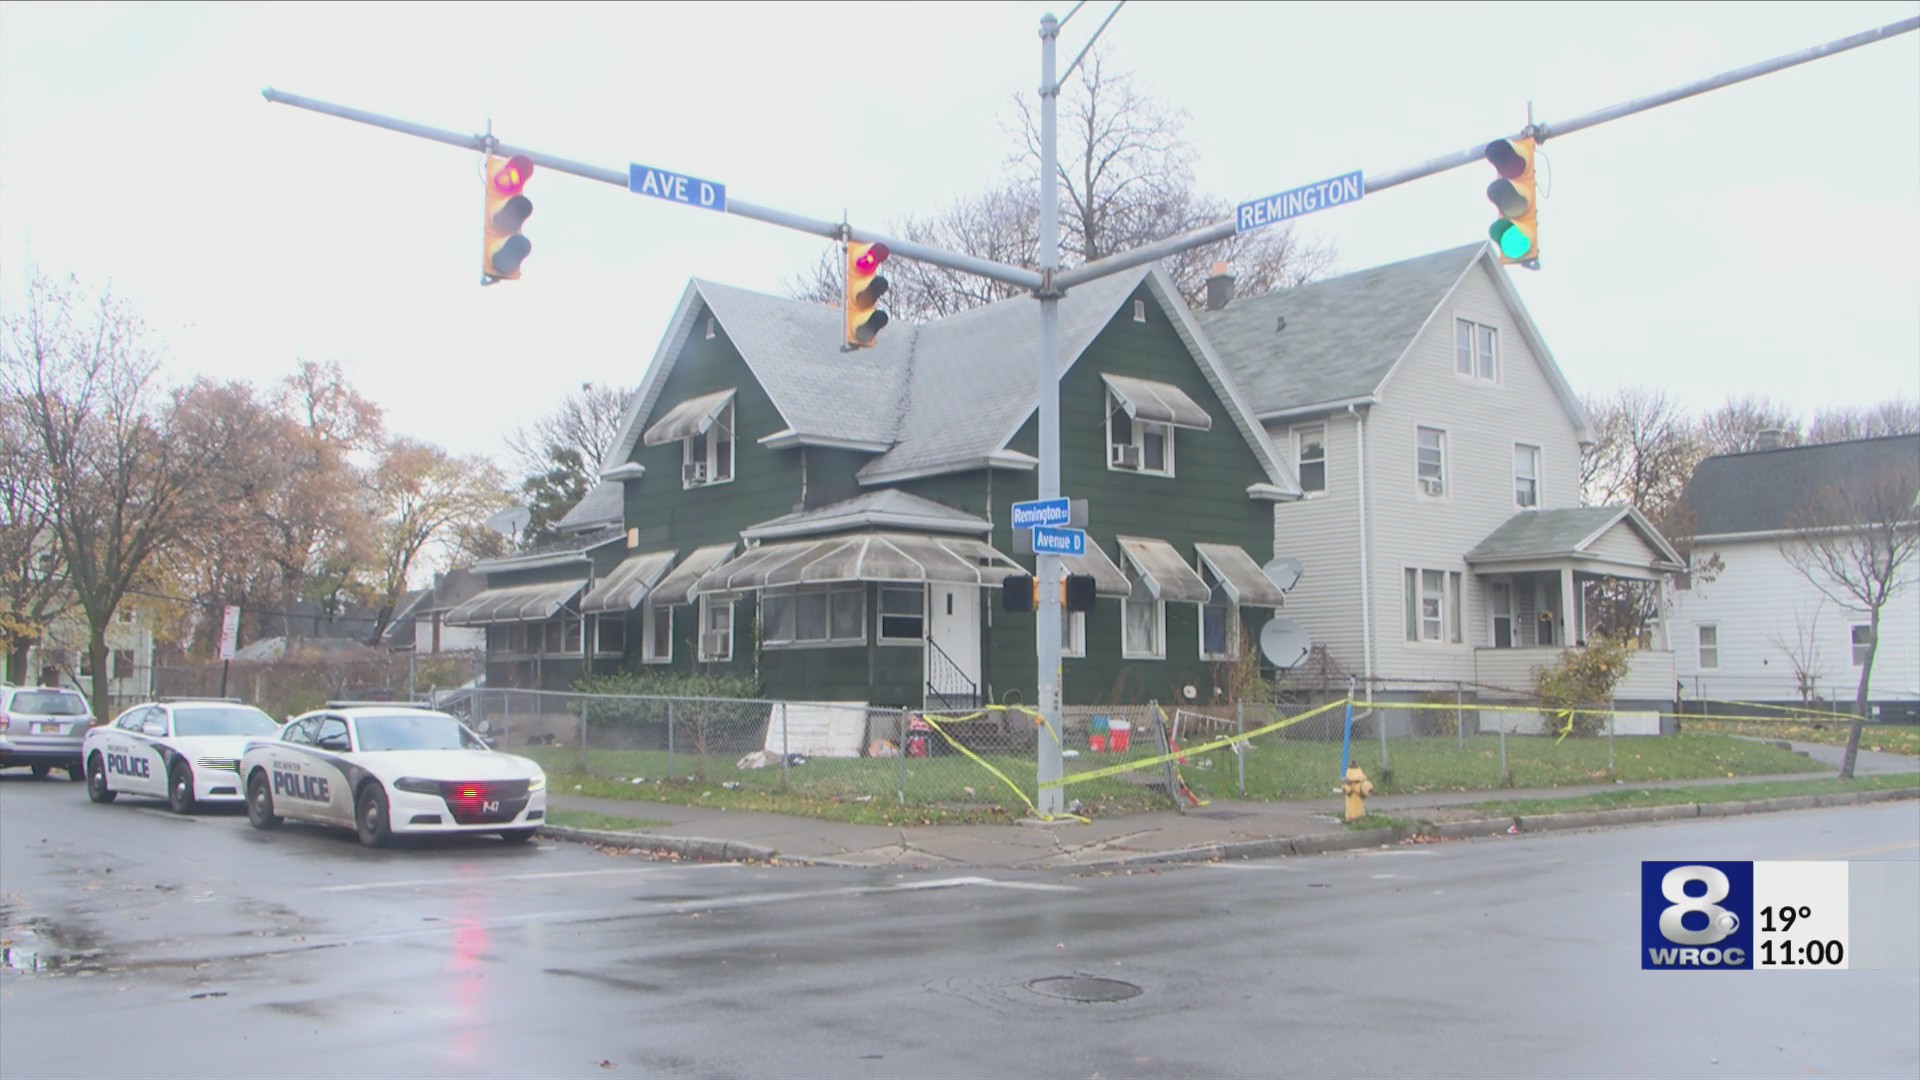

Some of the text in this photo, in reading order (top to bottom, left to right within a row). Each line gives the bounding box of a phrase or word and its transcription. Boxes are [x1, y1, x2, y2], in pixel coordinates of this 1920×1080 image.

[642, 169, 715, 206] AVE D
[1241, 175, 1359, 229] REMINGTON
[1014, 506, 1061, 525] Remington
[1037, 531, 1081, 550] Avenue D
[107, 753, 150, 779] POLICE
[273, 770, 330, 803] POLICE
